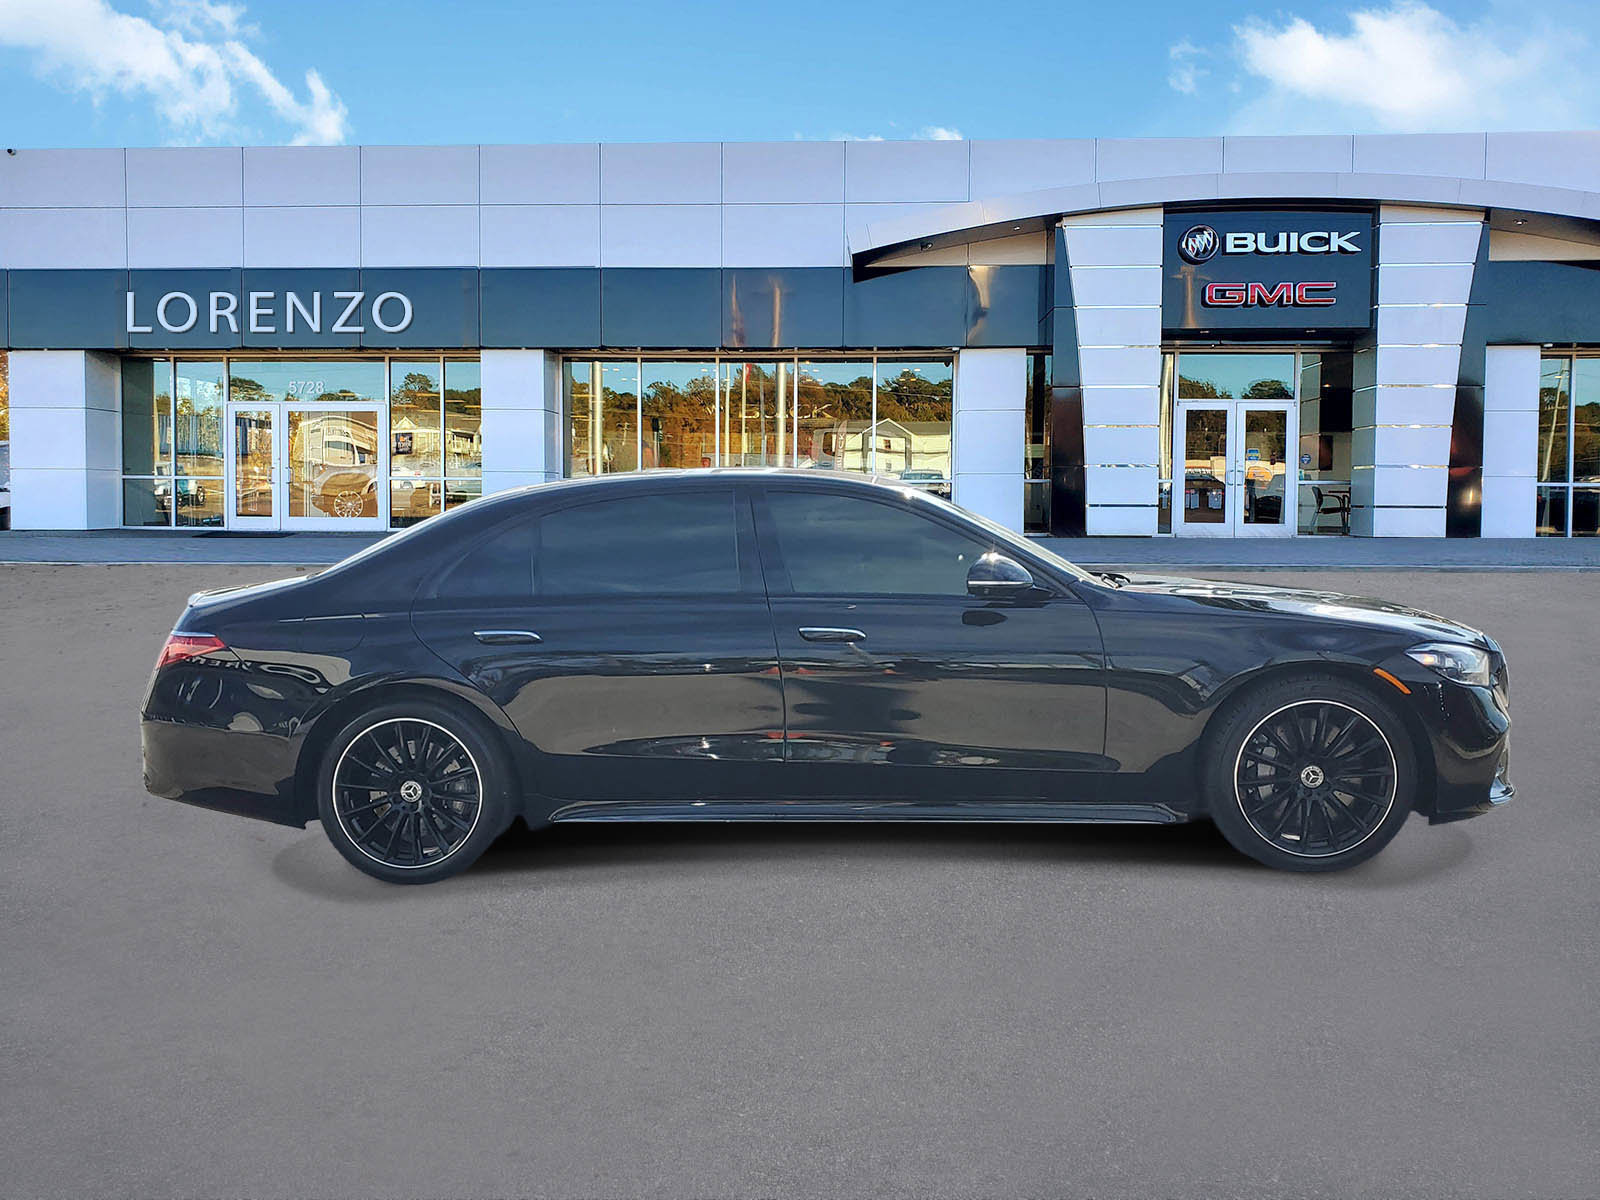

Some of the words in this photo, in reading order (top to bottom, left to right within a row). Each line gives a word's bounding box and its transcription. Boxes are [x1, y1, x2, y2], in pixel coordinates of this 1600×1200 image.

[1225, 231, 1362, 254] BUICK
[1205, 282, 1337, 305] GMC
[126, 291, 414, 334] LORENZO
[288, 380, 325, 394] 5728
